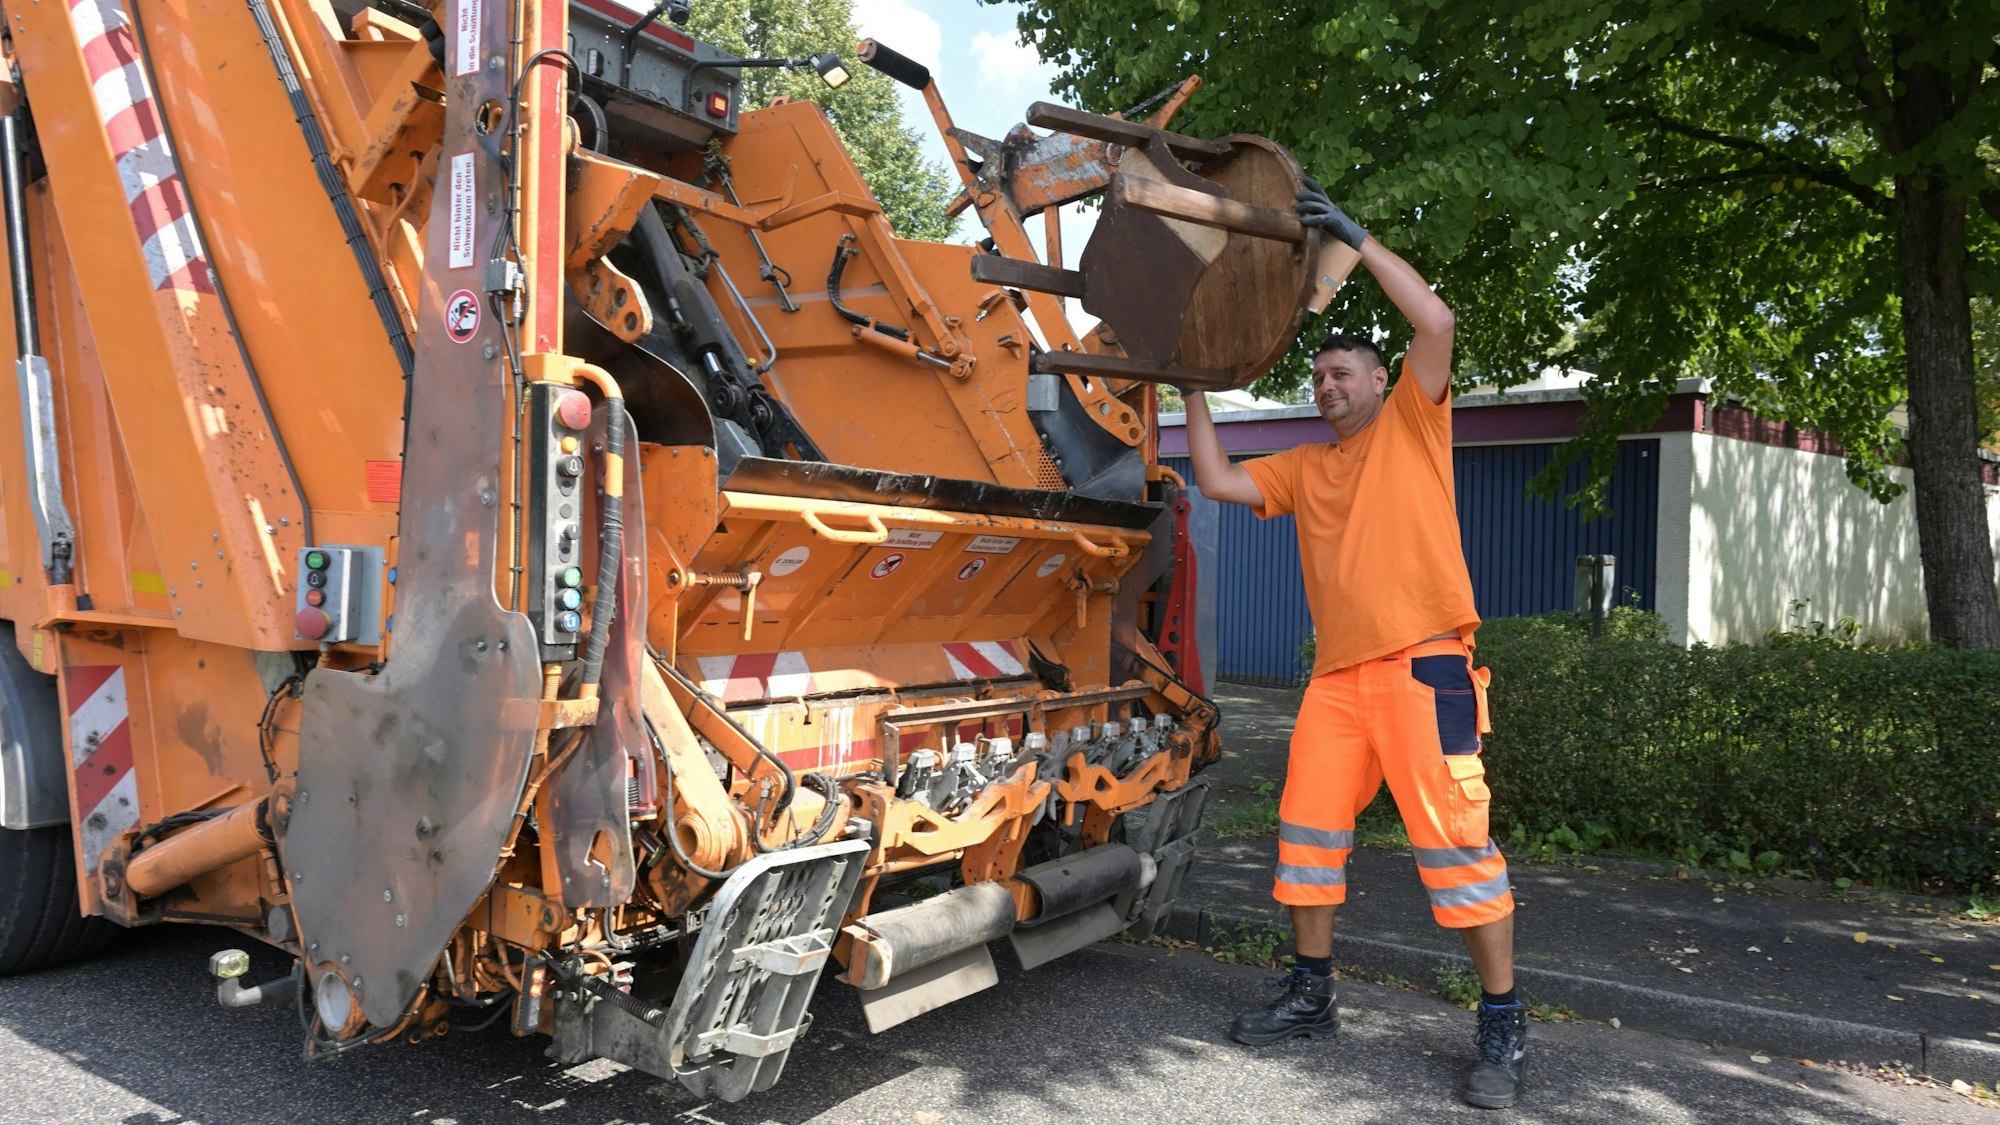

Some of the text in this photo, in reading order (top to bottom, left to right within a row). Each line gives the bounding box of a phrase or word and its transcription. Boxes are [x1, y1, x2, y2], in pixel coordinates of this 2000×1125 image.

[468, 62, 475, 70] in
[453, 225, 461, 251] Nicht
[463, 195, 471, 258] Schwenkarm
